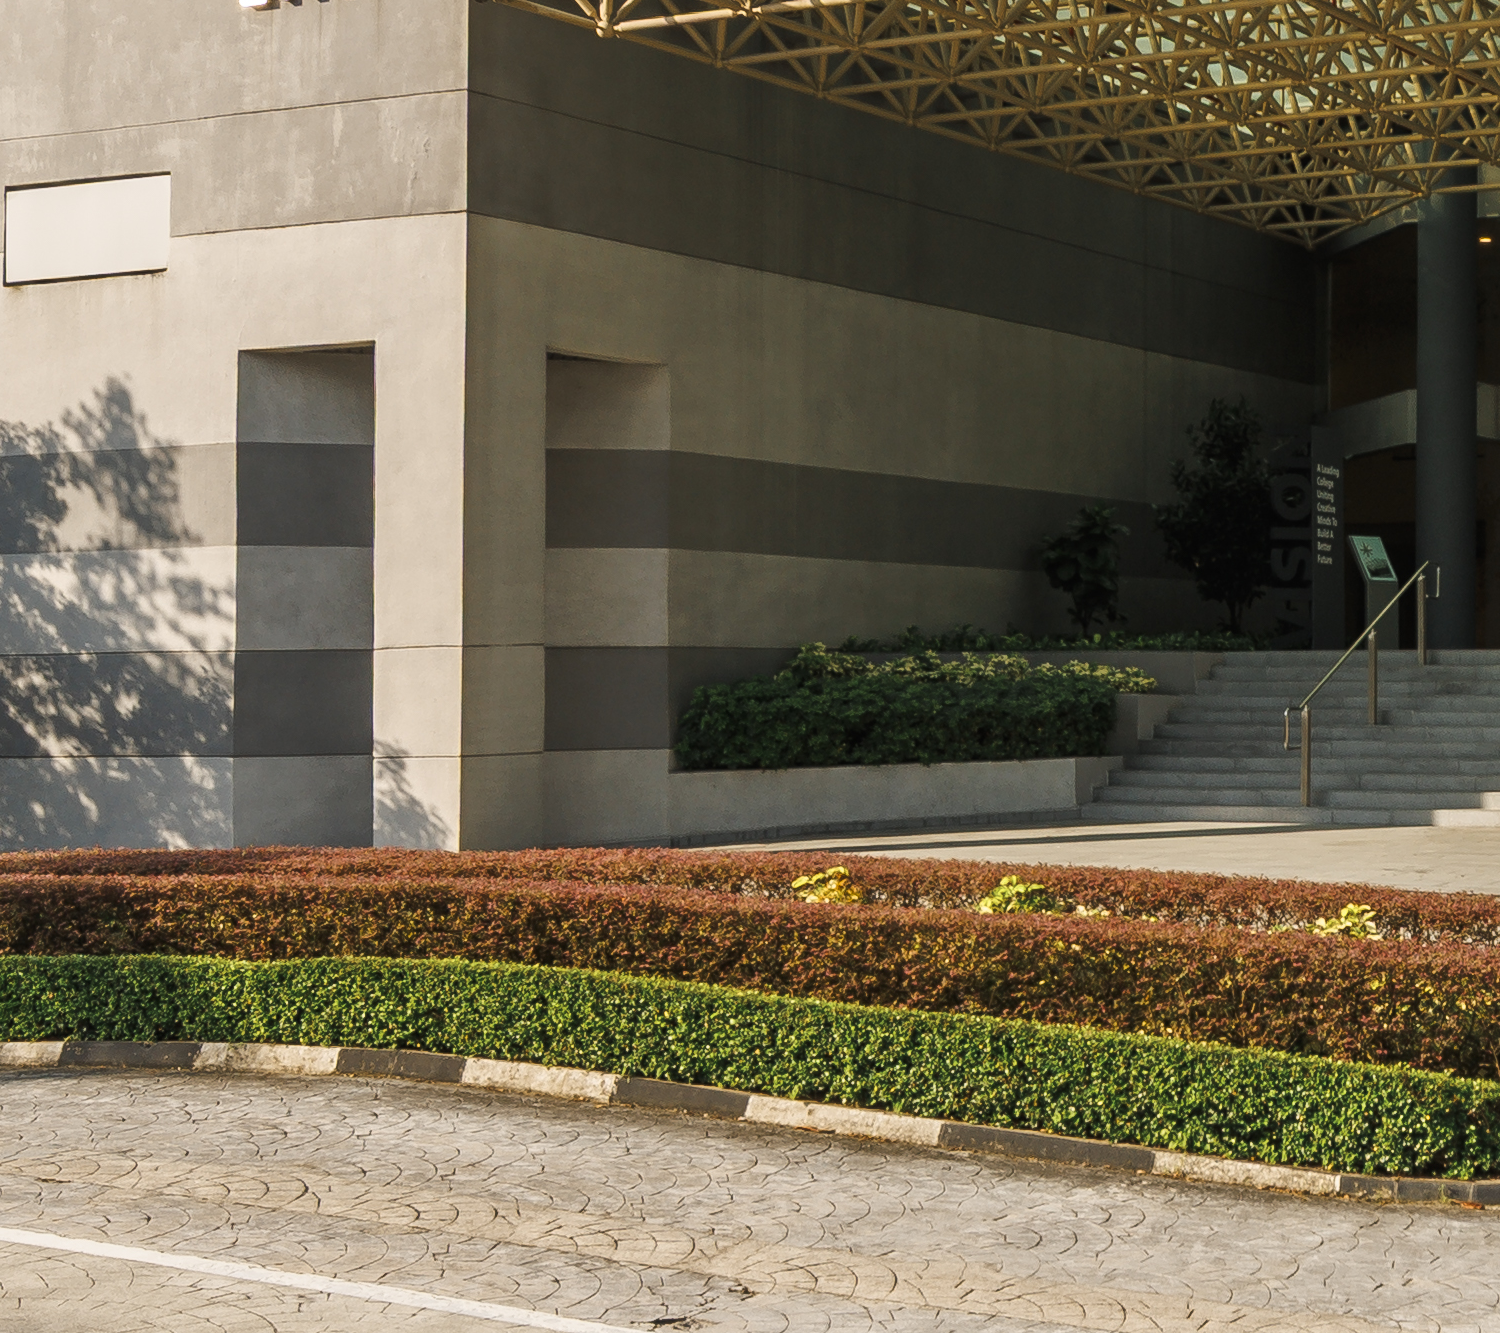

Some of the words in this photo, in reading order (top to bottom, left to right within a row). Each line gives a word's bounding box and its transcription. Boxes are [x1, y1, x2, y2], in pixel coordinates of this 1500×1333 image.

[1316, 464, 1321, 473] A
[1321, 465, 1340, 478] Leading
[1316, 476, 1334, 490] College
[1316, 490, 1334, 503] Uniting
[1316, 502, 1336, 514] Creative
[1317, 515, 1332, 526] Minds
[1317, 528, 1330, 539] Build
[1317, 541, 1332, 552] Better
[1317, 554, 1333, 565] Future
